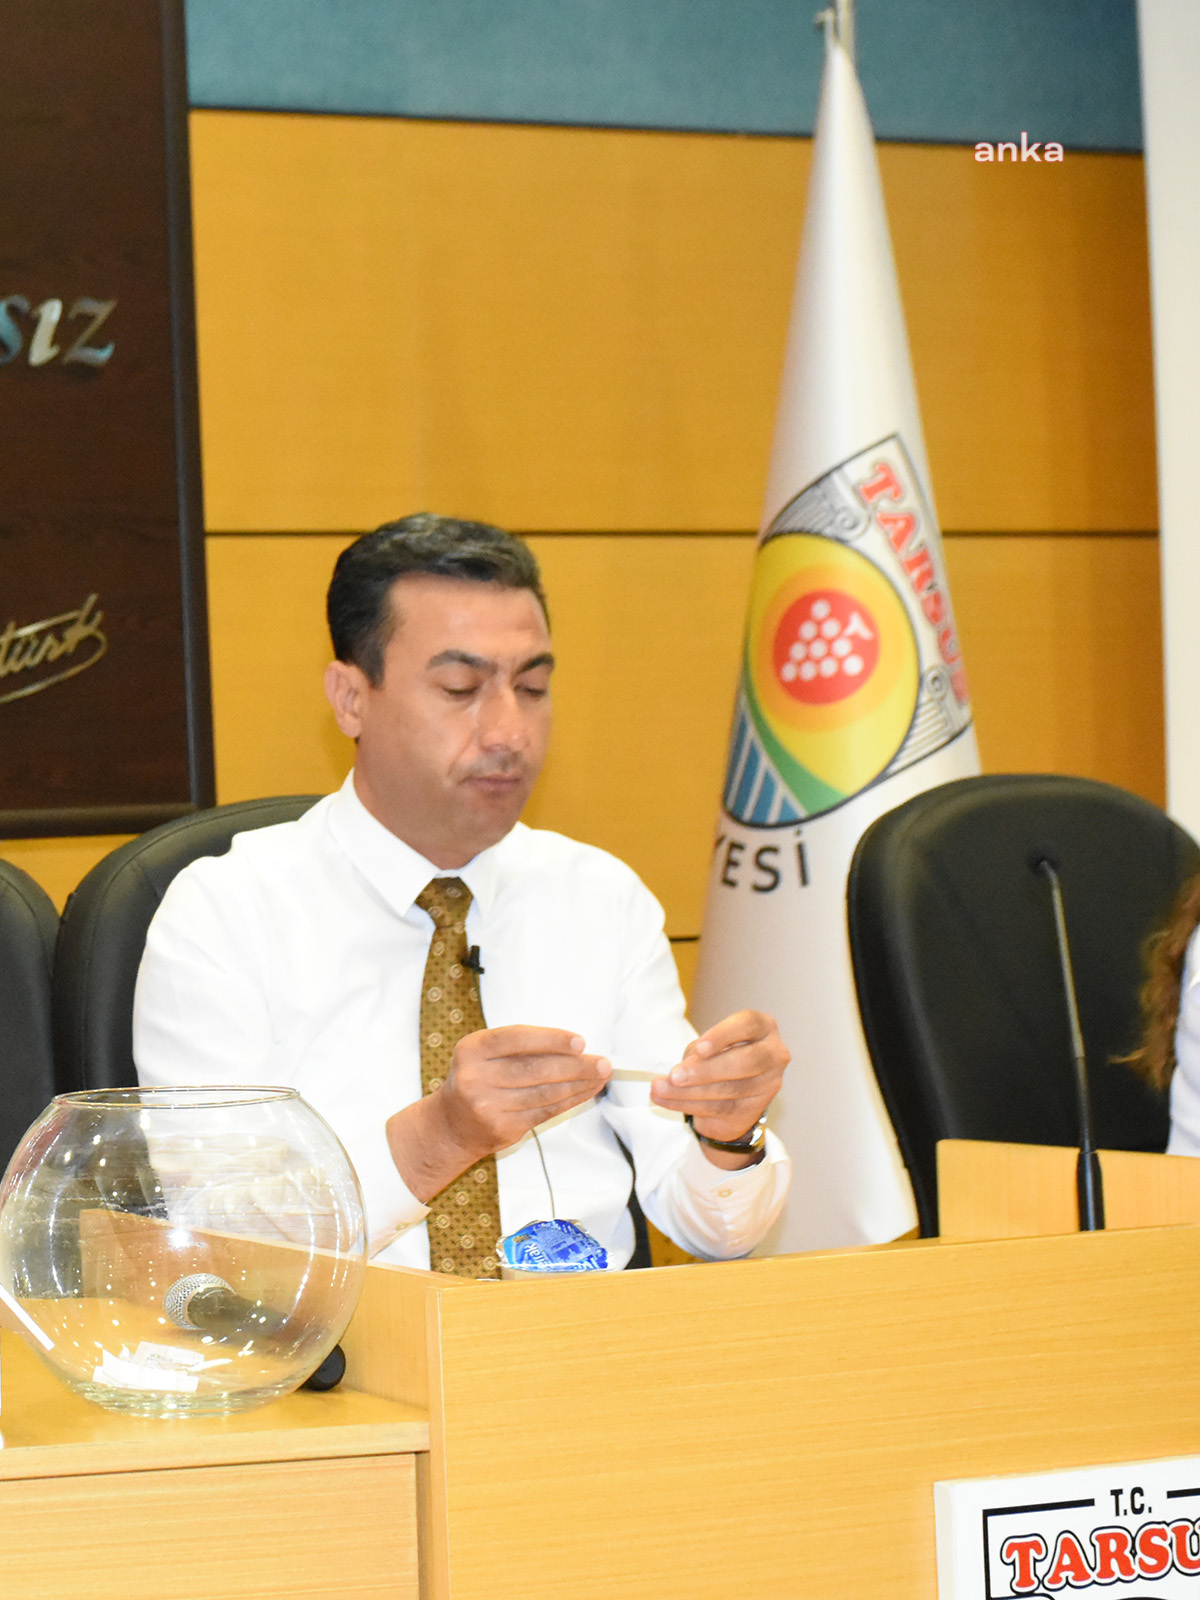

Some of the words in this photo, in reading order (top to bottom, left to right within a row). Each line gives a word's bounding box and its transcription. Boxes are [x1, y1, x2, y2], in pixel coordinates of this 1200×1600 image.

[714, 829, 810, 894] ESİ
[1110, 1486, 1152, 1516] T.C.
[1000, 1518, 1200, 1594] TARSU
